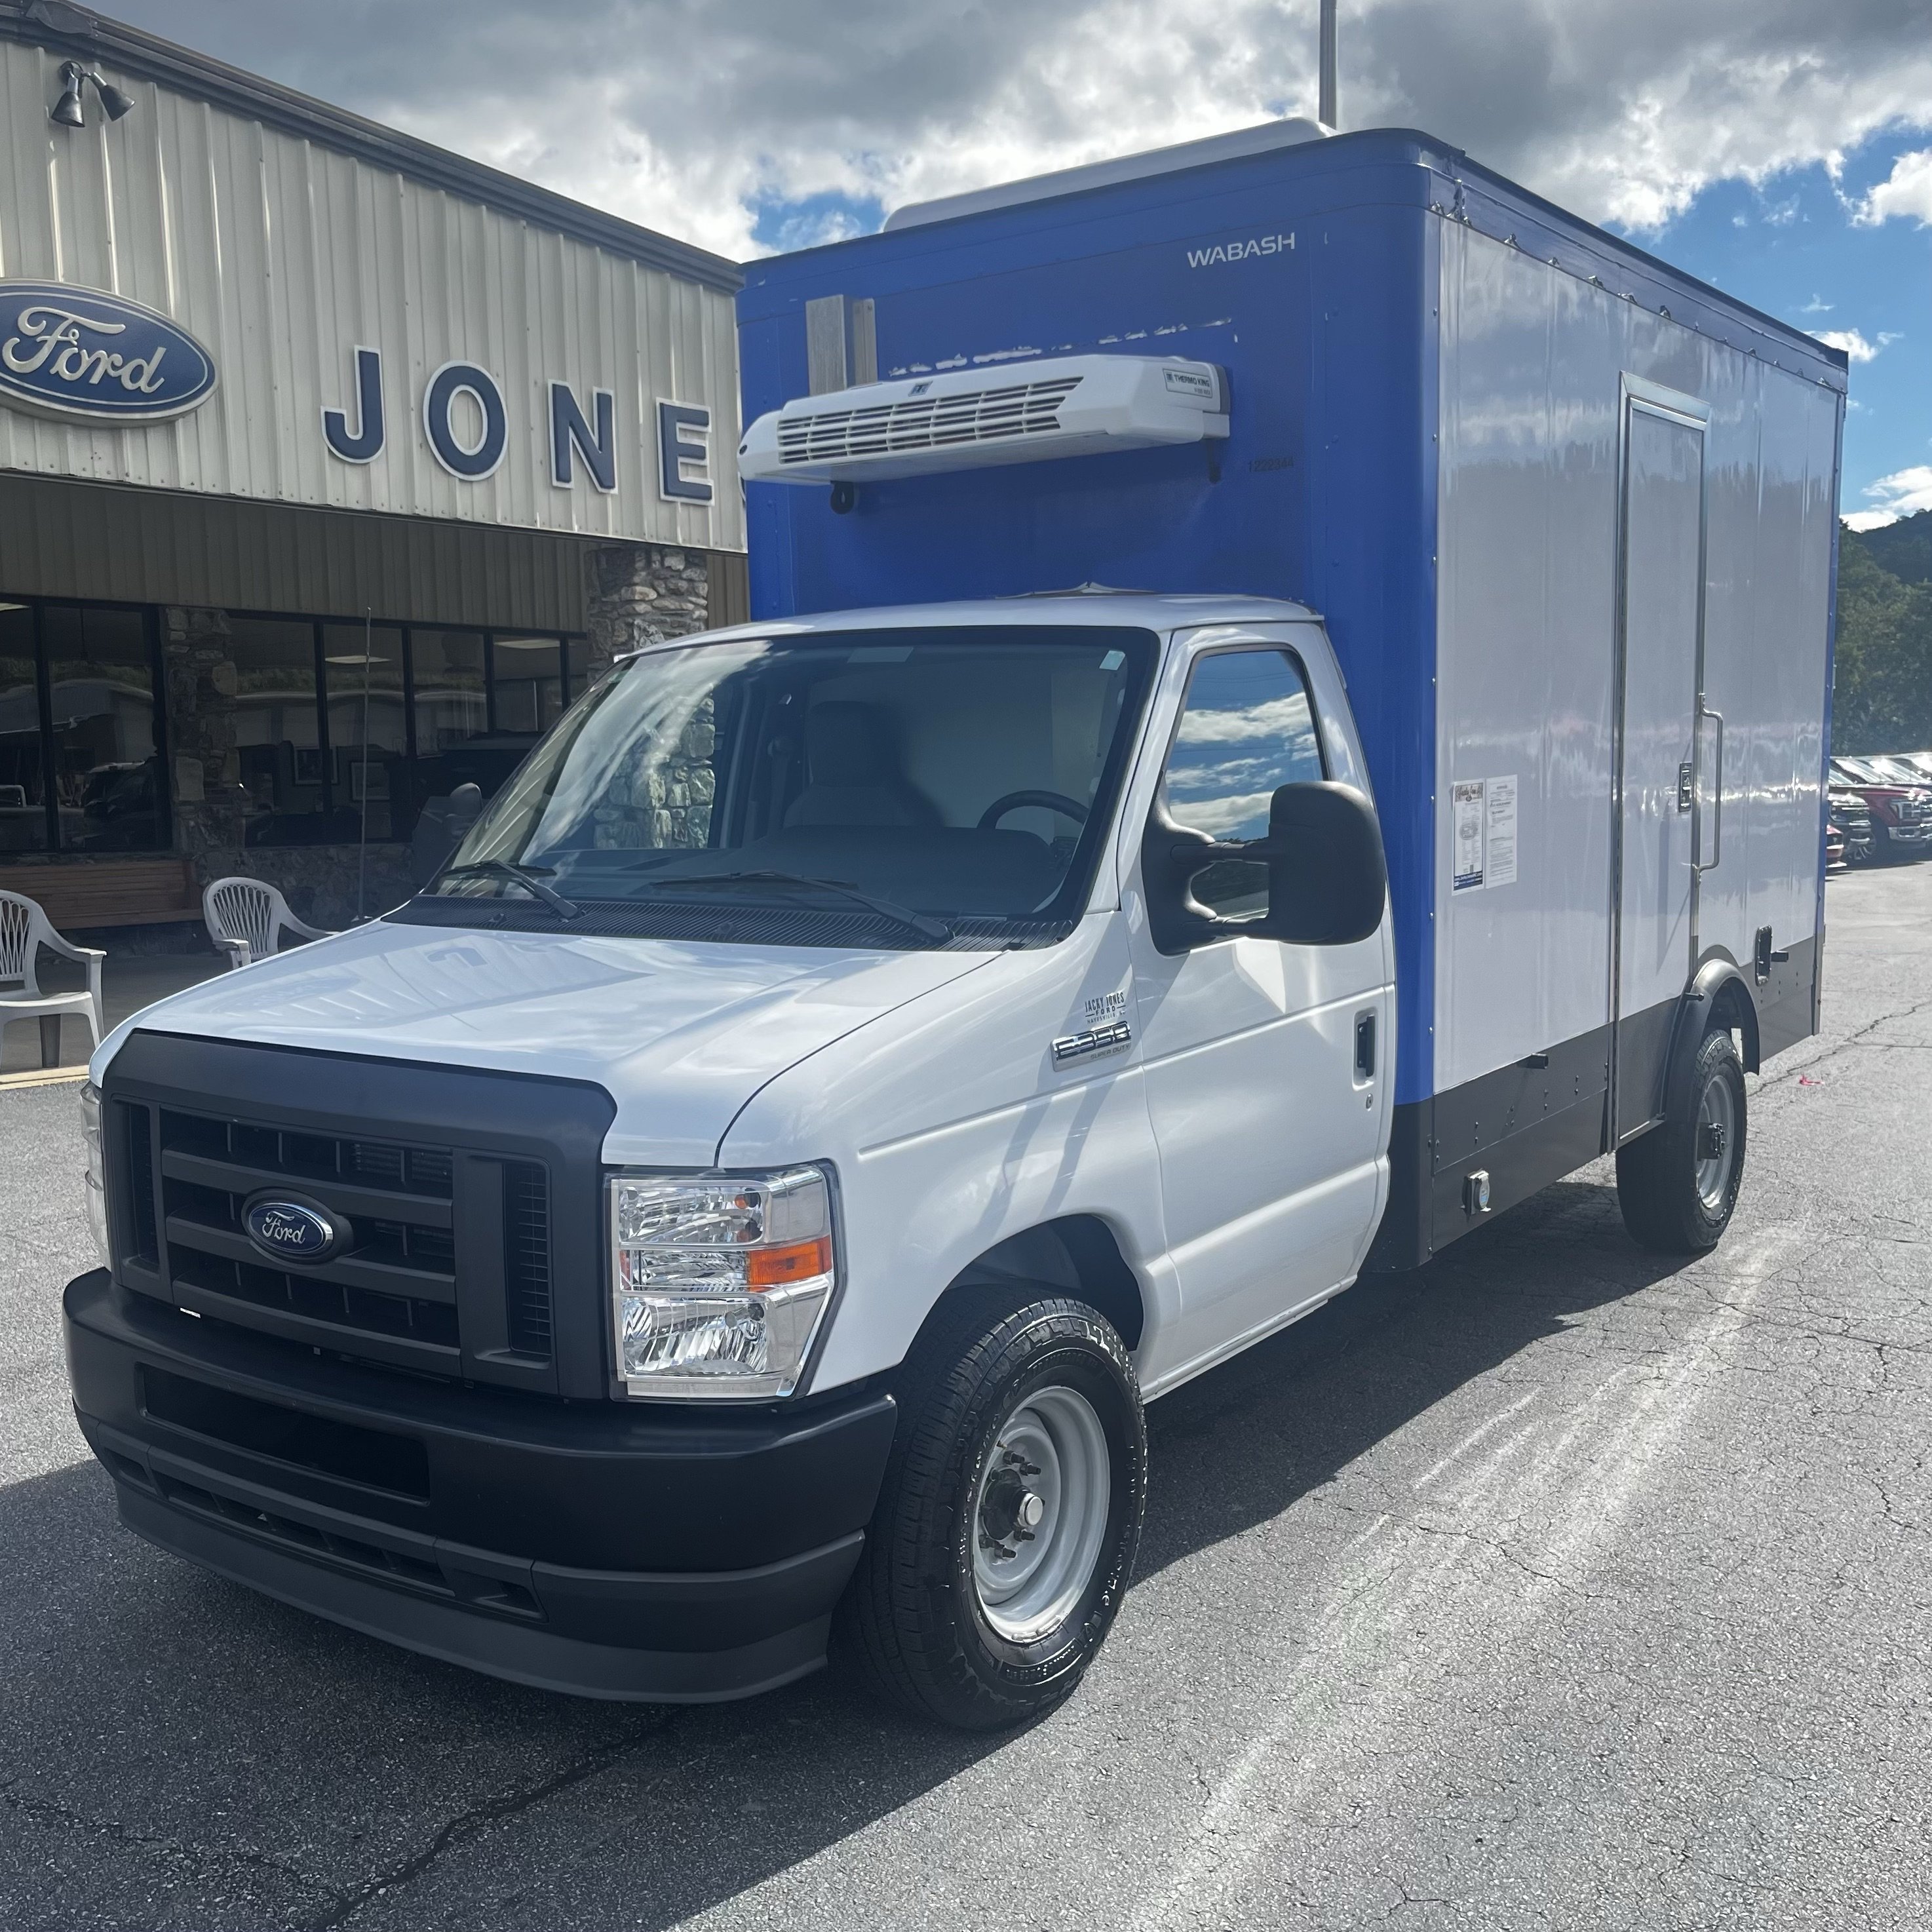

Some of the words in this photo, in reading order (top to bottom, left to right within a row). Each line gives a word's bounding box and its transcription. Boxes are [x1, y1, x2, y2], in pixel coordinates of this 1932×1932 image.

[1187, 232, 1295, 268] WABASH
[2, 306, 166, 395] Ford
[1174, 374, 1197, 385] THERMO
[1198, 379, 1210, 387] KING
[321, 345, 716, 506] JONE
[1085, 997, 1104, 1013] JACKY
[1106, 992, 1125, 1007] JONES
[1095, 1005, 1115, 1016] FORD
[262, 1211, 306, 1244] Ford
